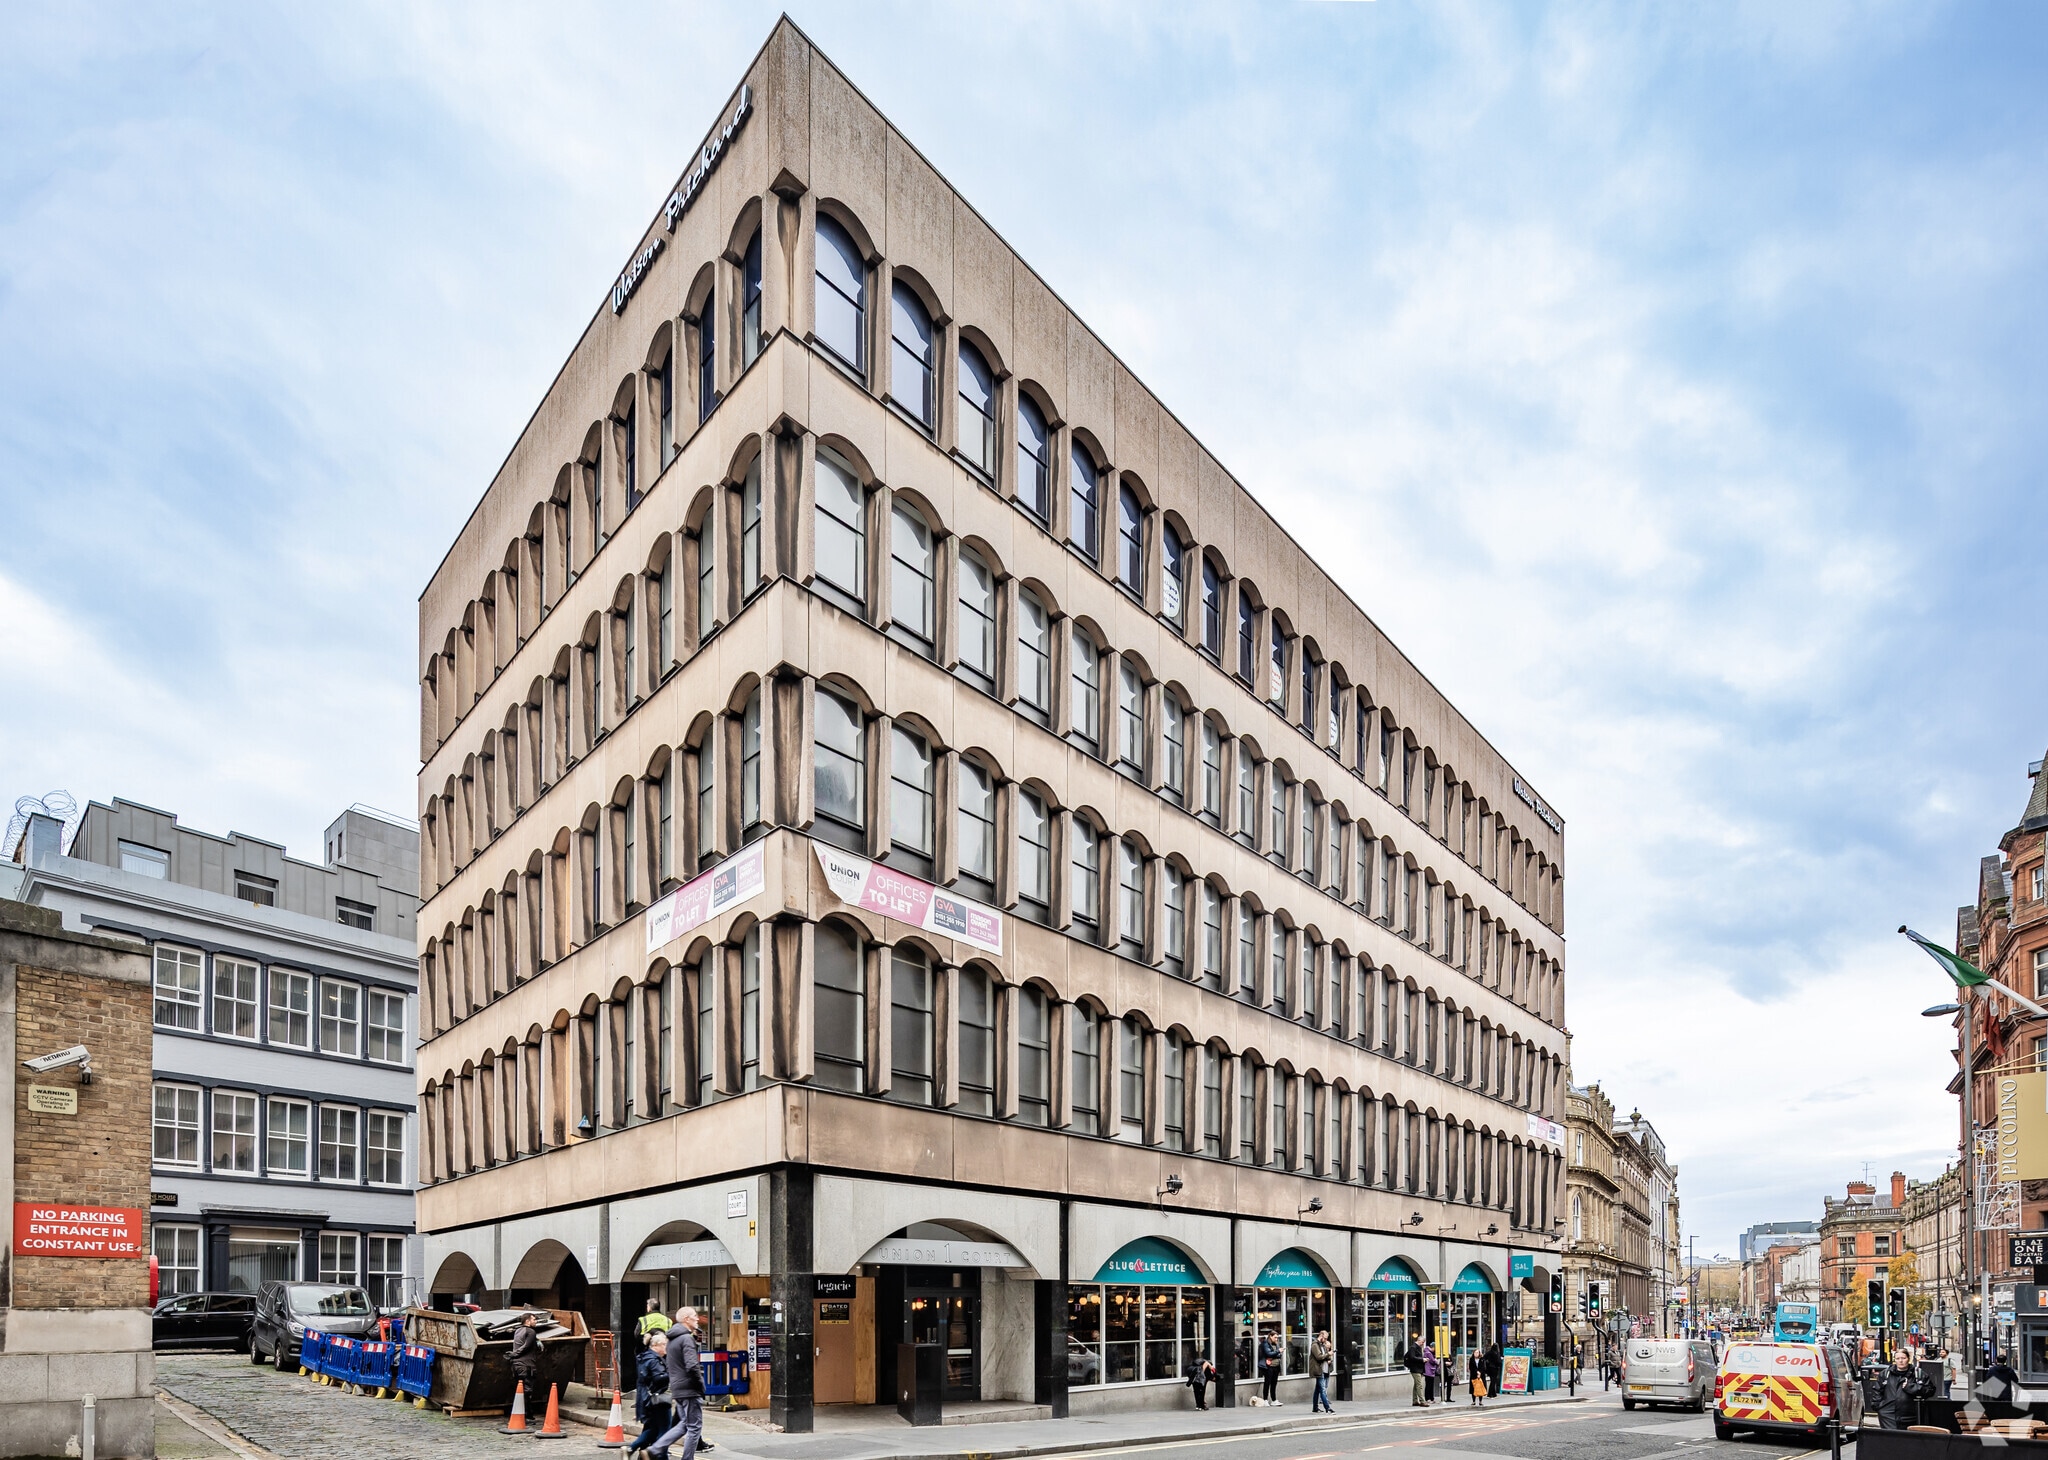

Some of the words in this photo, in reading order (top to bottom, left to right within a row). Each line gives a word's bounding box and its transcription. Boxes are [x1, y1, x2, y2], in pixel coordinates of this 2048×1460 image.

[829, 871, 857, 887] COURT
[830, 863, 860, 880] UNION
[714, 874, 729, 889] GVA
[678, 883, 710, 911] OFFICES
[876, 875, 927, 904] OFFICES
[868, 888, 888, 905] TO
[890, 896, 913, 915] LET
[935, 898, 956, 916] GVA
[674, 914, 686, 930] TO
[686, 904, 700, 924] LET
[36, 1089, 70, 1097] WARNING
[2001, 1079, 2018, 1176] PICCOLINO
[32, 1209, 57, 1220] NO
[60, 1210, 125, 1222] PARKING
[30, 1224, 109, 1237] ENTRANCE
[112, 1228, 128, 1238] IN
[22, 1238, 105, 1251] CONSTANT
[108, 1241, 134, 1252] USE
[2014, 1245, 2043, 1253] ONE
[690, 1249, 725, 1264] COURT
[878, 1247, 936, 1262] UNION
[944, 1242, 952, 1264] 1
[960, 1251, 1011, 1264] COURT
[2014, 1256, 2043, 1265] BAR
[1514, 1263, 1529, 1271] SAL
[817, 1279, 851, 1294] legacie
[1656, 1346, 1675, 1354] NWB
